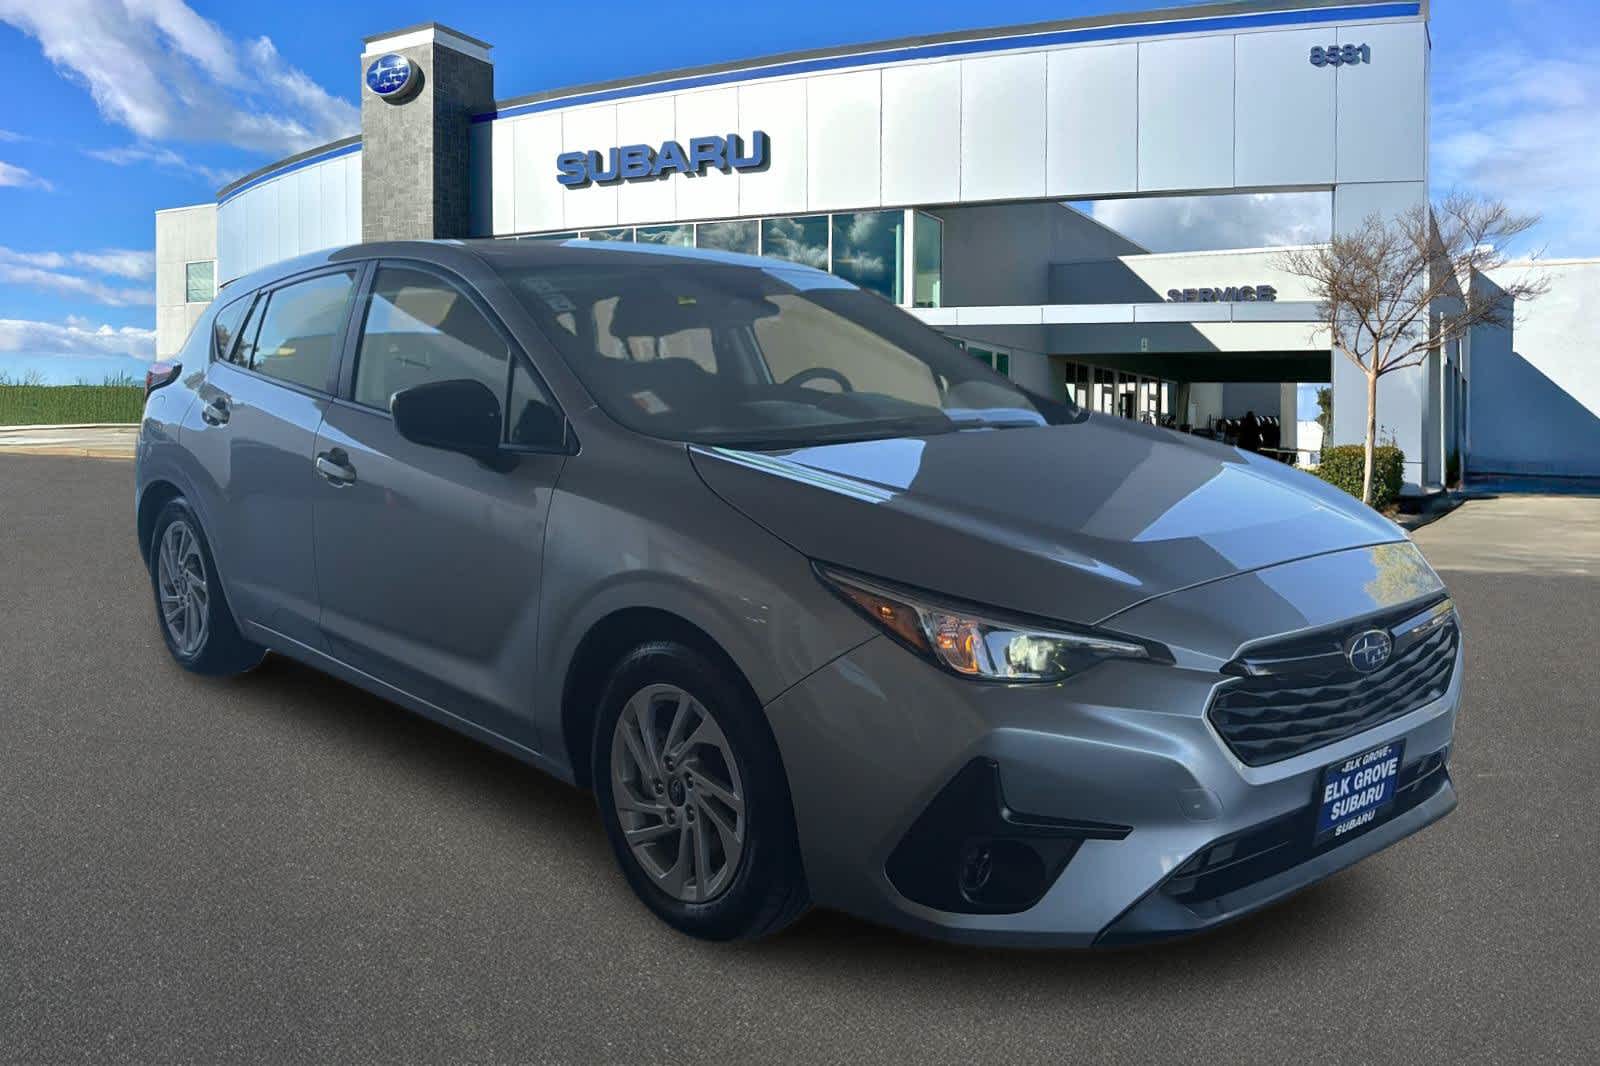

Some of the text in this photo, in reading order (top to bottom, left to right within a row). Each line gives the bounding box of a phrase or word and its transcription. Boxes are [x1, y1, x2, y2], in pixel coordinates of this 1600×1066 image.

[556, 130, 771, 190] SUBARU
[1167, 285, 1277, 302] SERVICE
[1323, 757, 1398, 803] ELK GROVE
[1331, 783, 1385, 820] SUBARU
[1335, 810, 1376, 836] SUBARU
